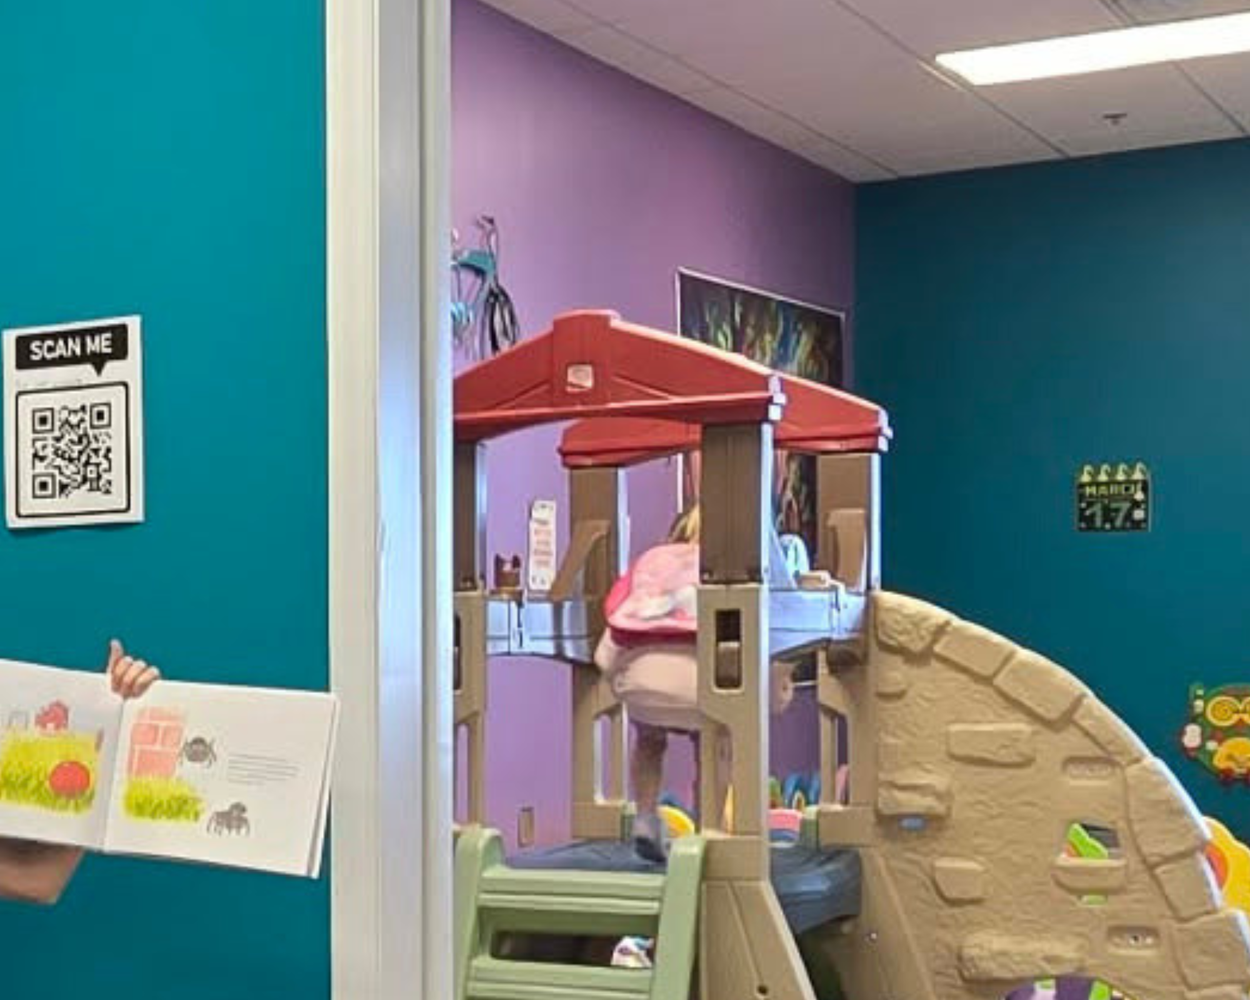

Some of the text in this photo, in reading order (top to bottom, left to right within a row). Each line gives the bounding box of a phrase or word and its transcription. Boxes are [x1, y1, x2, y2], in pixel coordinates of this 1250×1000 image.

[30, 333, 112, 361] SCAN ME
[1085, 502, 1131, 528] 17
